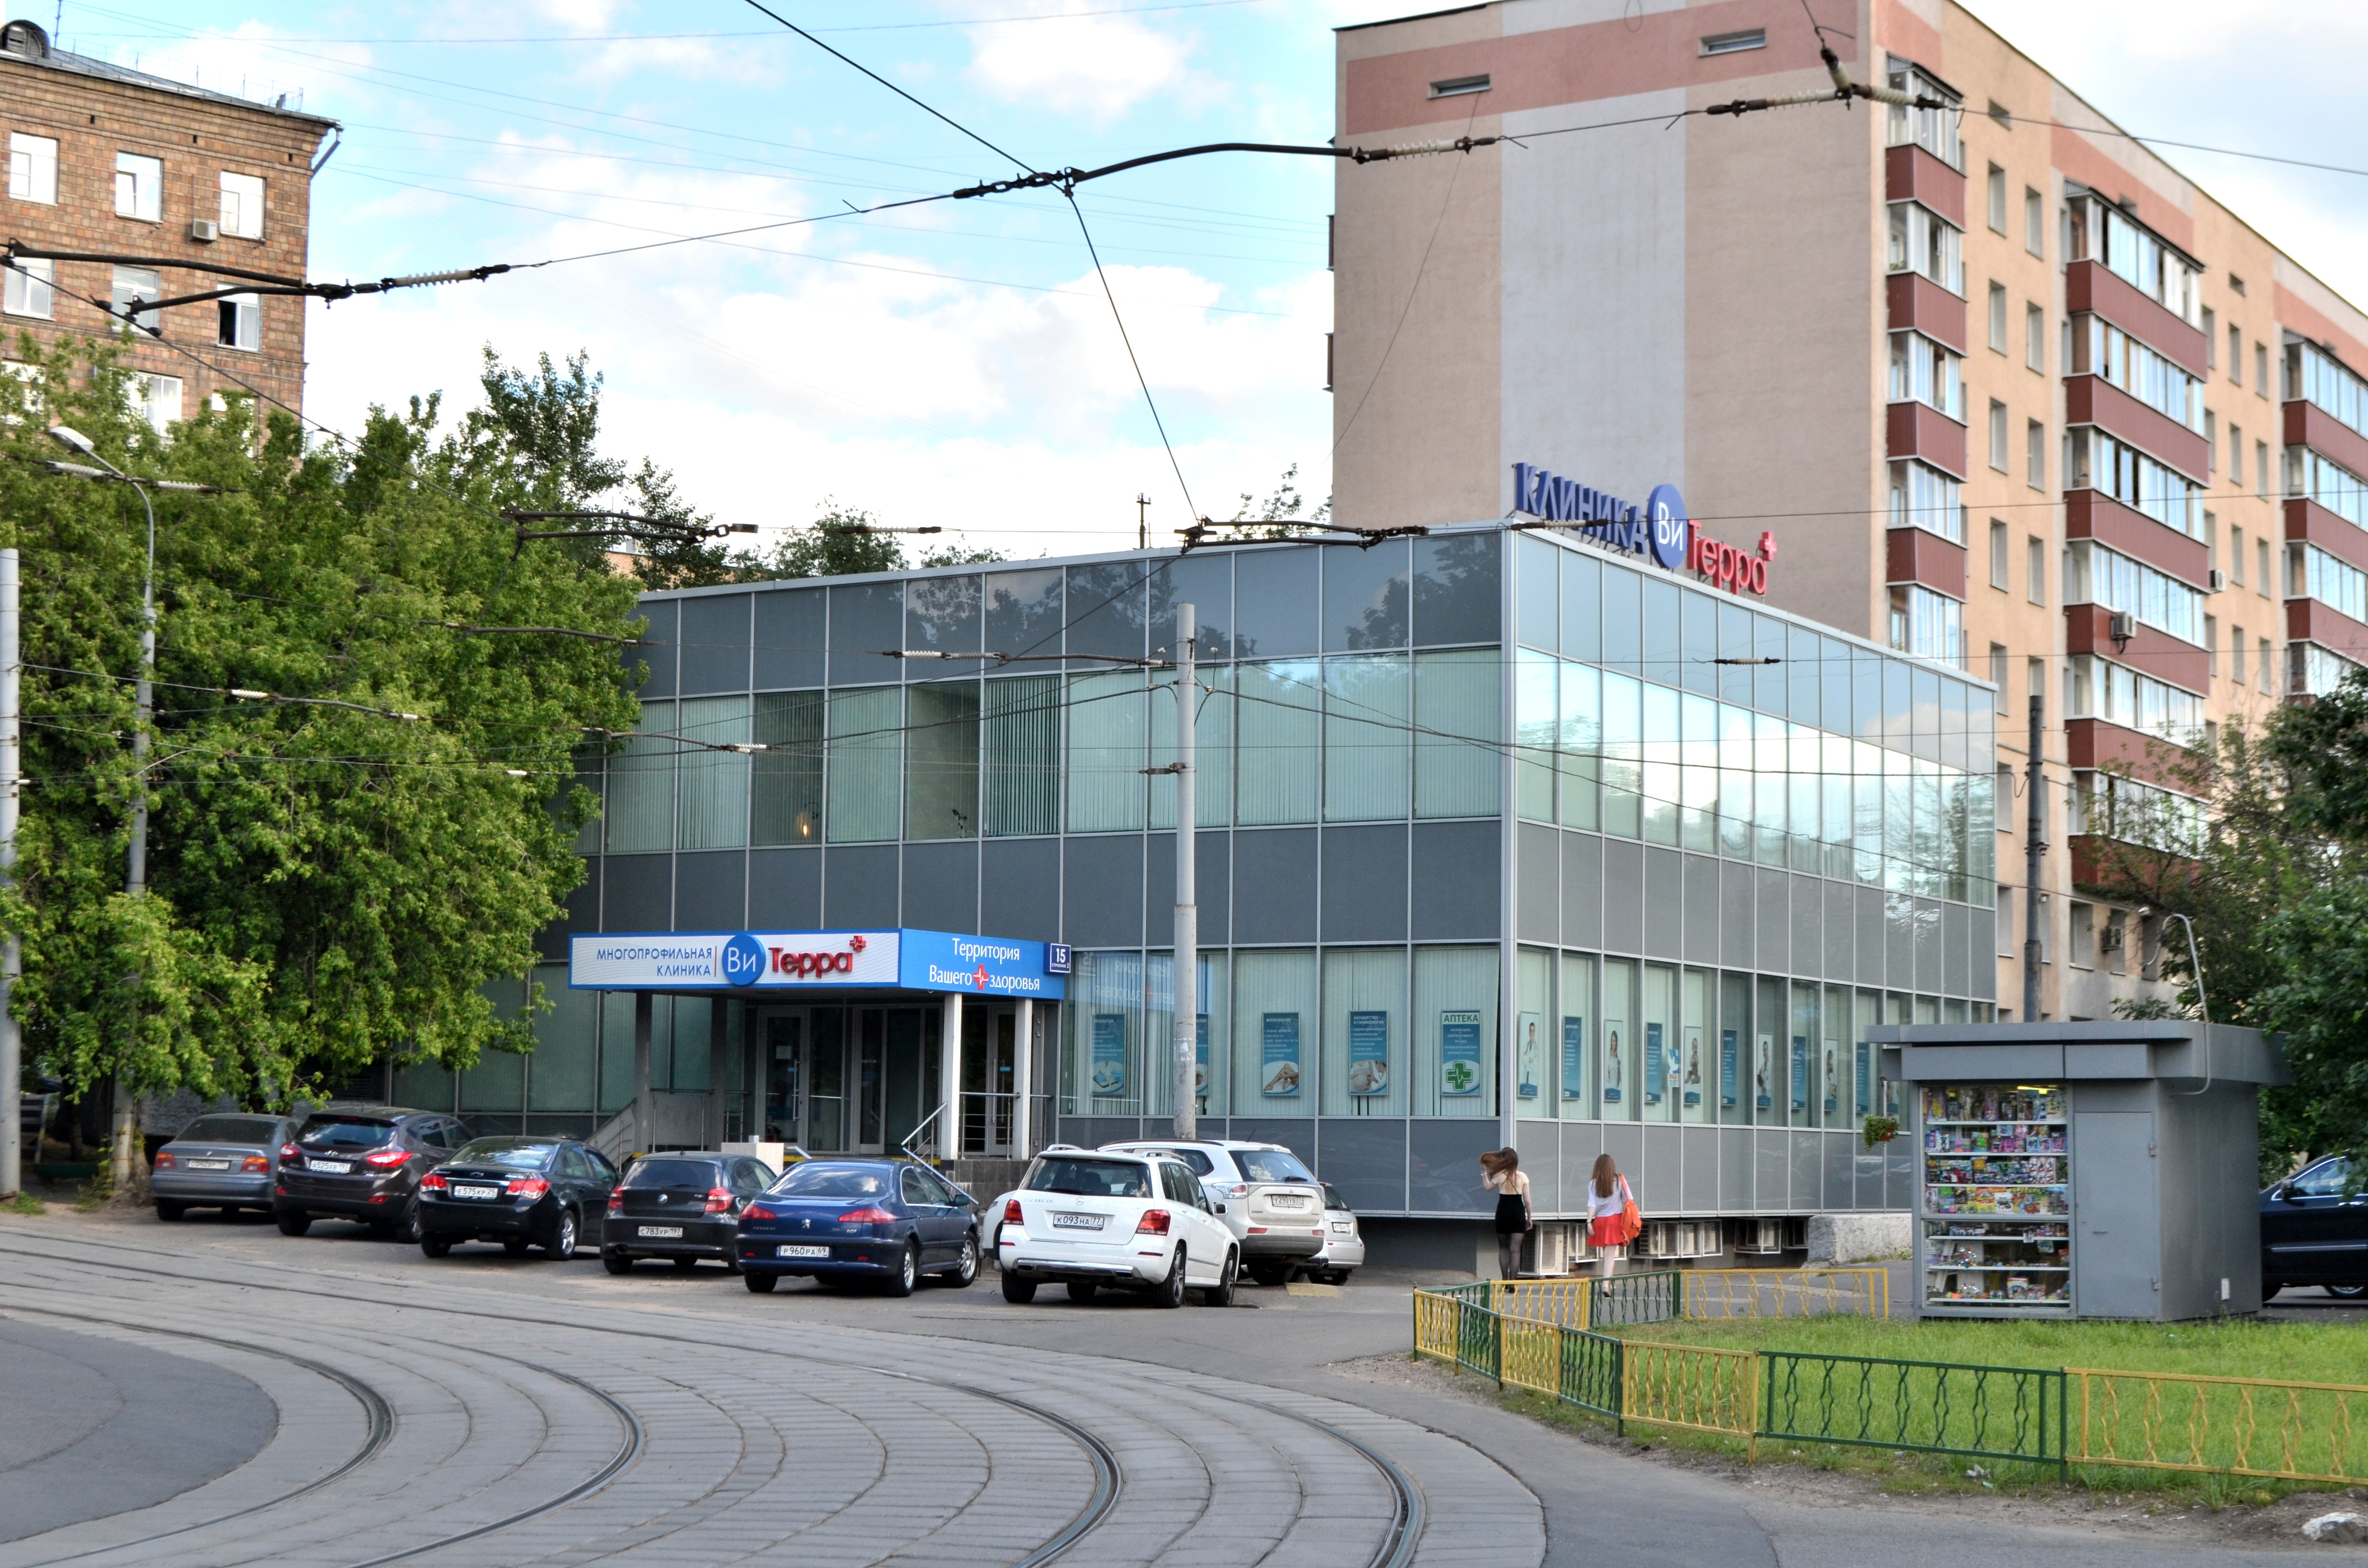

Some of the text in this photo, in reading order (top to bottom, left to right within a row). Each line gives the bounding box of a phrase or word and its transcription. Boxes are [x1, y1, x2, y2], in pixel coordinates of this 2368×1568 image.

[1516, 463, 1768, 595] КЛИНИКА Ви Терра
[597, 948, 712, 960] МНОГОПРОФИЛЬНАЯ
[952, 938, 1020, 965] Территория
[1056, 948, 1066, 963] 15
[728, 947, 853, 979] Ви Терра
[657, 965, 711, 976] КЛИНИКА
[929, 964, 1040, 993] Вашего здоровья
[1443, 1014, 1479, 1023] АПТЕКА
[312, 1162, 337, 1170] А525ХВ
[1274, 1195, 1295, 1204] У290УВ
[1057, 1216, 1090, 1225] К093НА
[641, 1227, 668, 1236] С783УР
[783, 1247, 815, 1255] Р960РА
